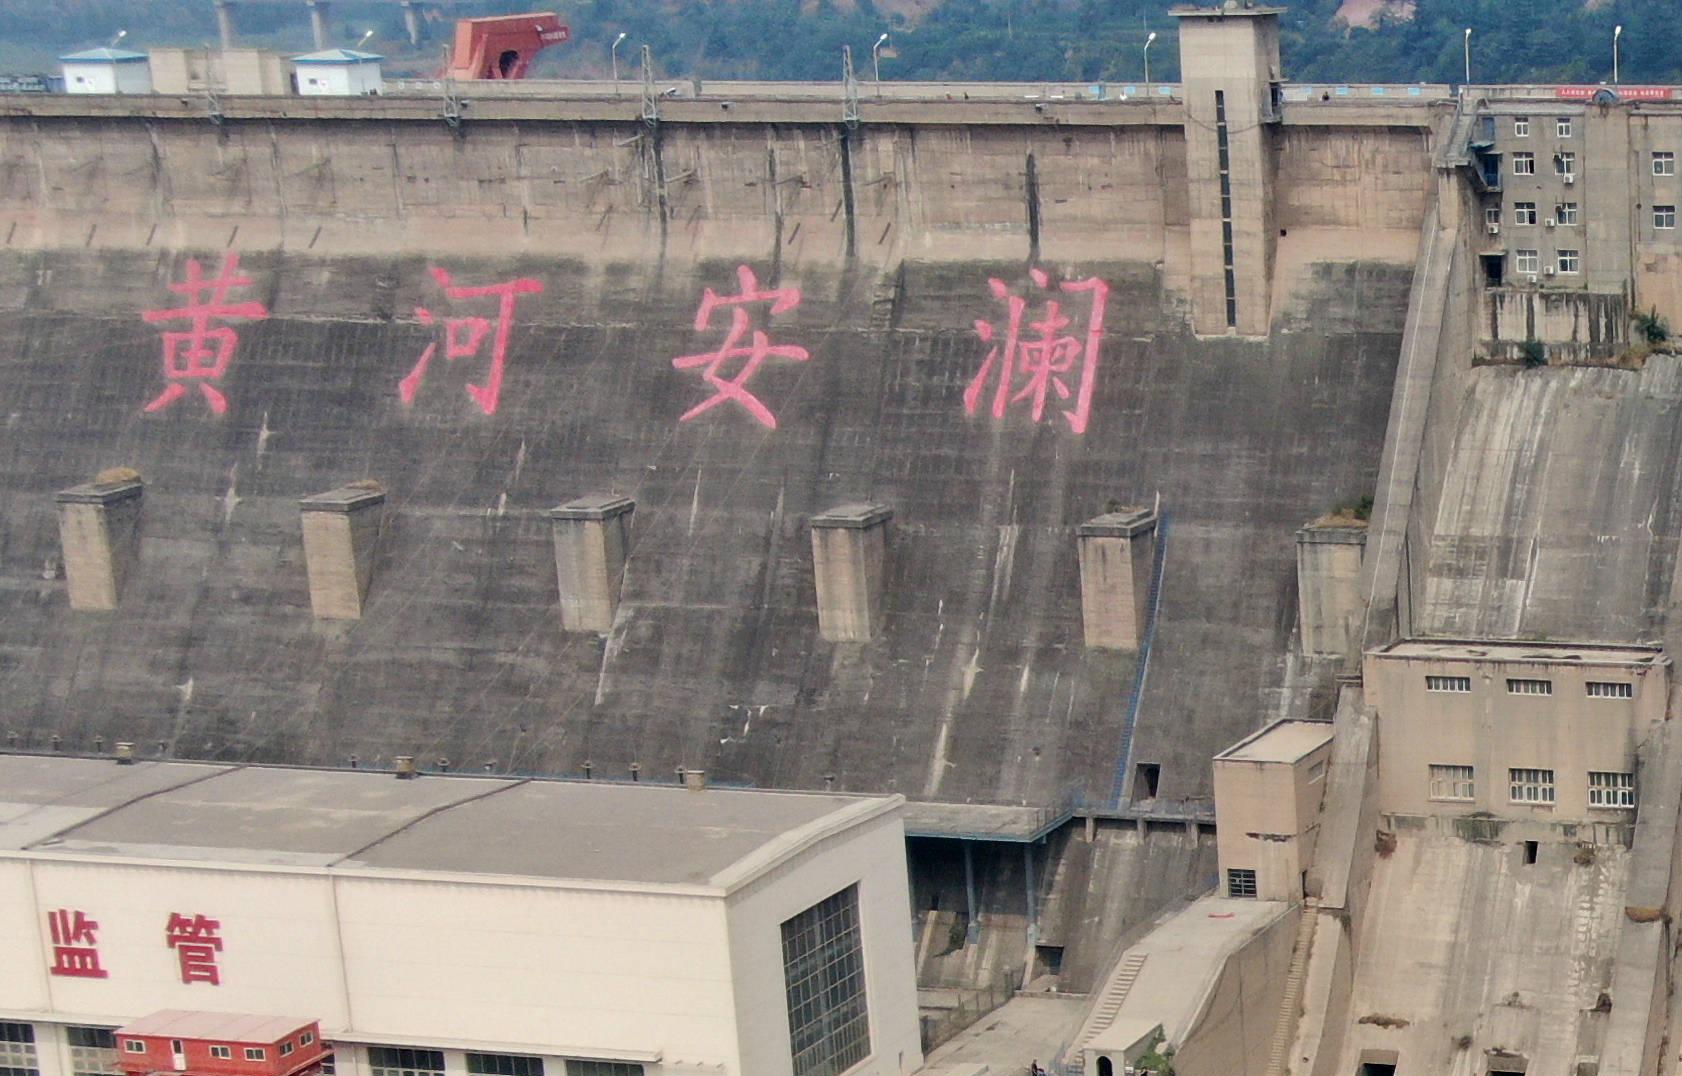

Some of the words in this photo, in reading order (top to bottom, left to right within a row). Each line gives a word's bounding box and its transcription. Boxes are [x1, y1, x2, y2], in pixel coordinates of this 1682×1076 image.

[142, 251, 1112, 435] 黄河安澜
[48, 908, 225, 986] 监管
